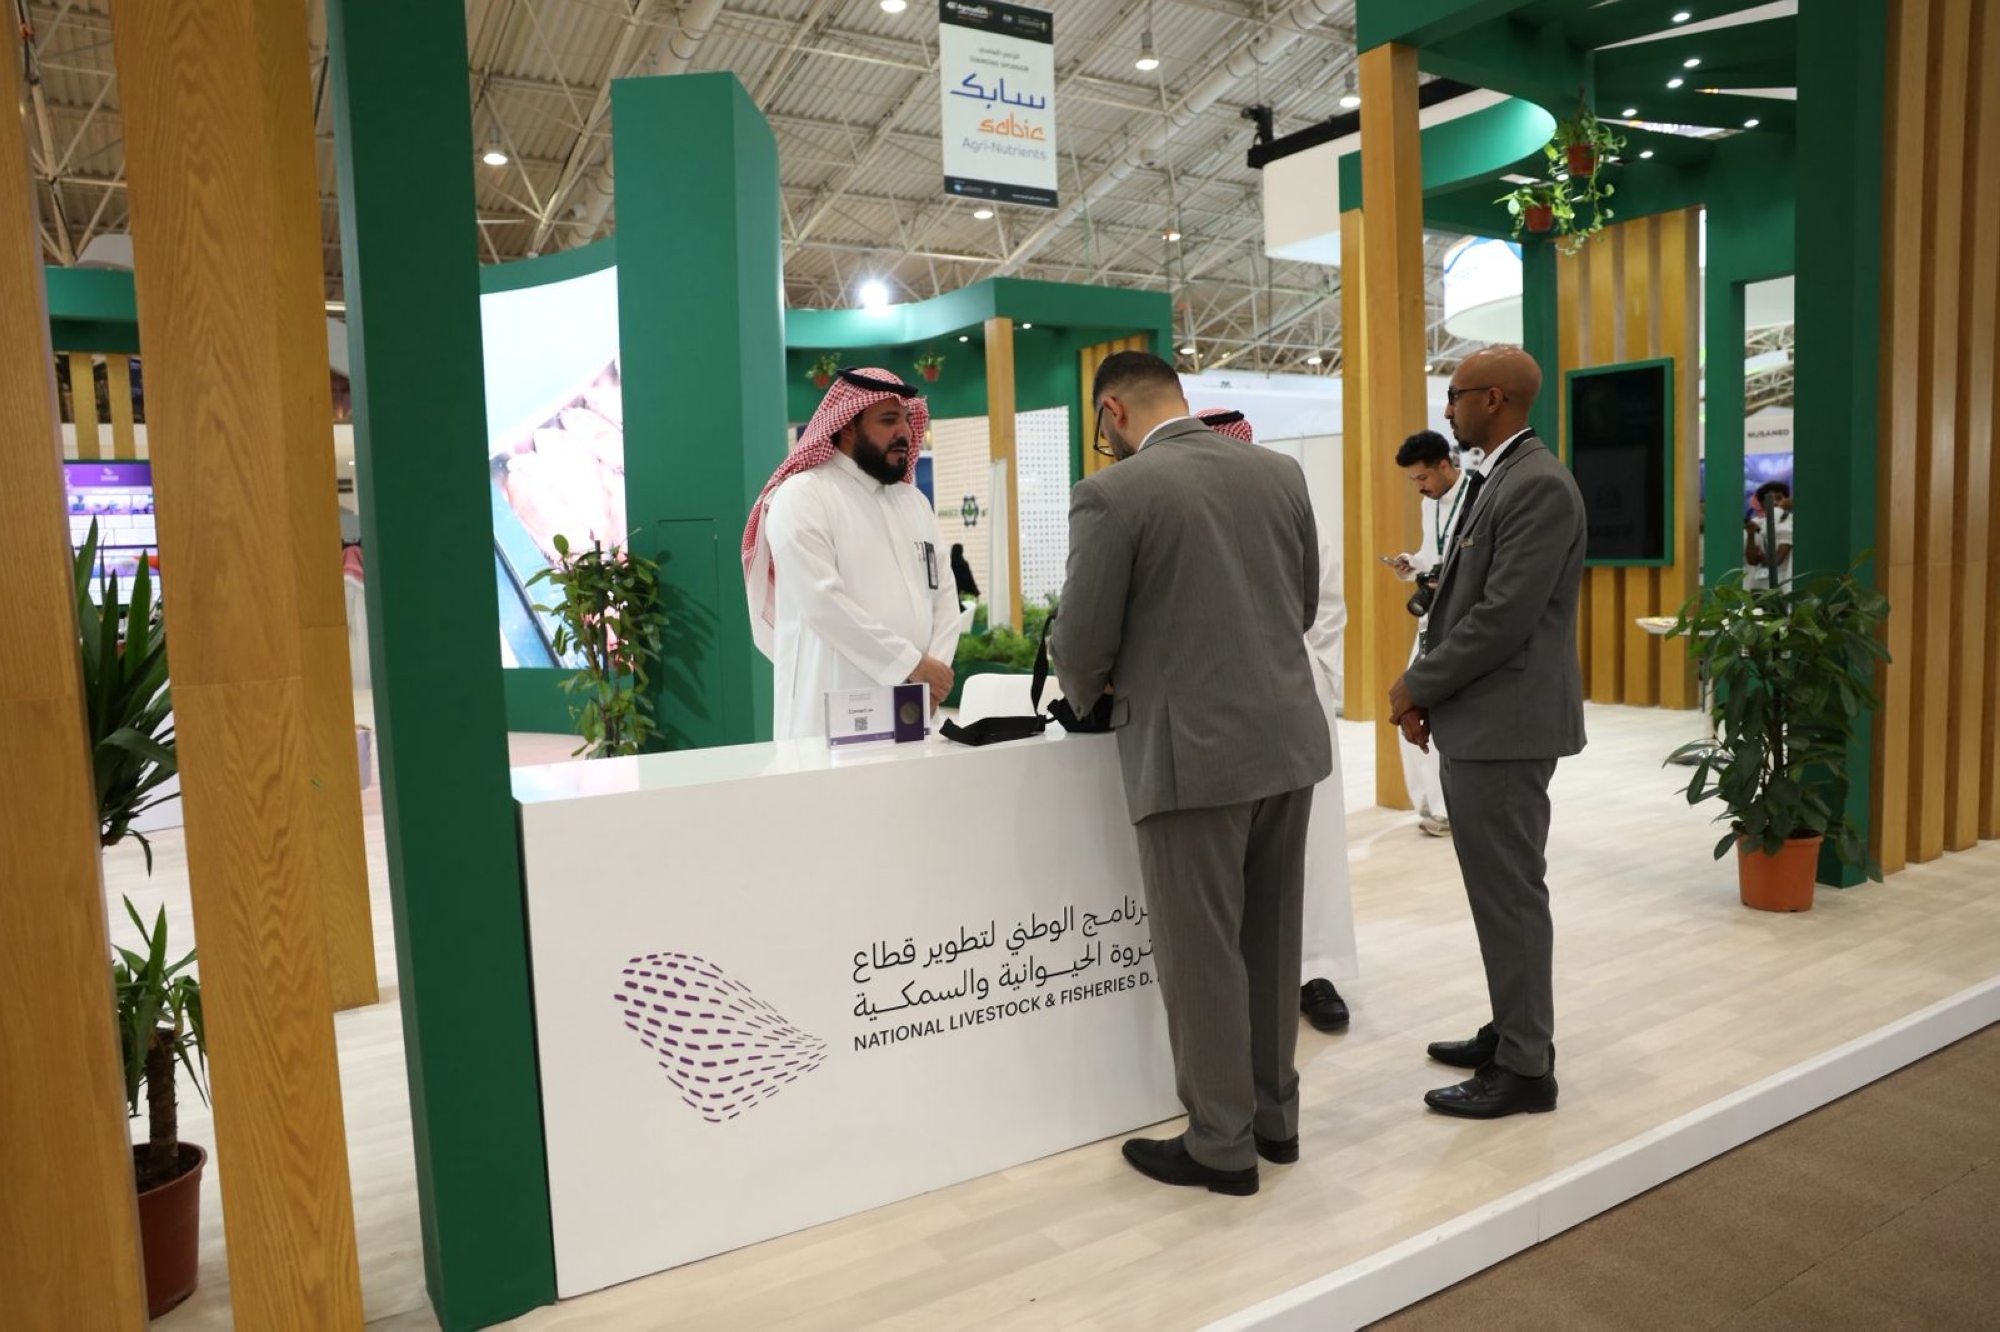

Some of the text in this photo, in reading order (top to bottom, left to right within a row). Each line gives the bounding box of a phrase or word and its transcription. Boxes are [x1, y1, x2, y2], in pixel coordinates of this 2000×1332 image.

[949, 73, 1046, 110] سابك
[962, 136, 1048, 161] Agri-Nutrients
[977, 112, 1048, 142] sabic
[853, 895, 1149, 983] رنامج الوطني لتطوير قطاع
[853, 939, 1153, 1021] روة الحيوانية والسمكية
[854, 1018, 945, 1051] NATIONAL
[950, 995, 1041, 1031] LIVESTOCK
[1045, 993, 1056, 1008] &
[1061, 974, 1136, 1005] FISHERIES
